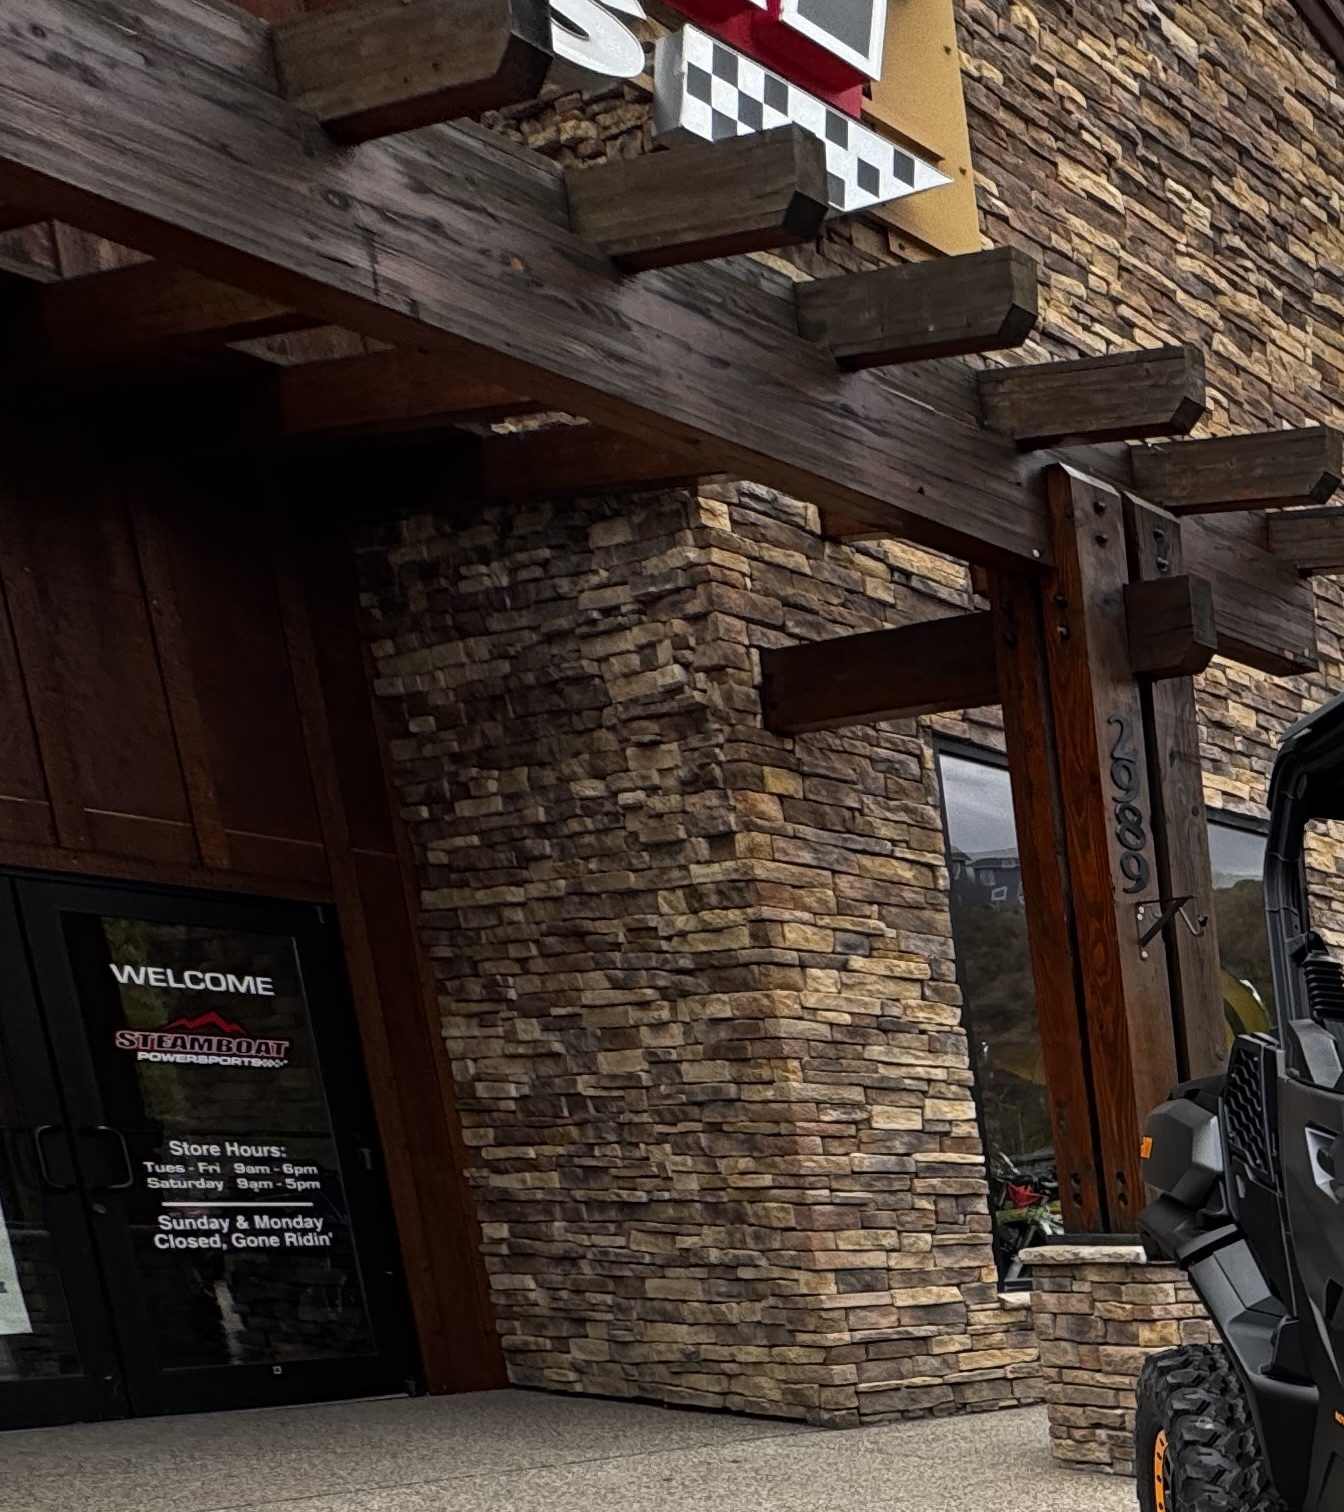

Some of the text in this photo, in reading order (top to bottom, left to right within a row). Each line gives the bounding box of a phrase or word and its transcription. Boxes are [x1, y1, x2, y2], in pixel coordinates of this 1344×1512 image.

[1107, 713, 1150, 894] 2989
[109, 963, 275, 996] WELCOME
[115, 1030, 290, 1058] STEAMBOAT
[137, 1051, 264, 1067] POWERSPORTS
[169, 1140, 287, 1158] Store Hours:
[143, 1161, 185, 1174] Tues
[198, 1161, 221, 1174] Fri
[234, 1162, 270, 1174] 9am
[282, 1163, 319, 1177] 6pm
[147, 1177, 224, 1191] Saturday
[236, 1177, 274, 1190] 9am
[285, 1178, 321, 1192] 5pm
[157, 1214, 323, 1233] Sunday & Monday
[153, 1231, 333, 1251] Closed, Gone Ridin'
